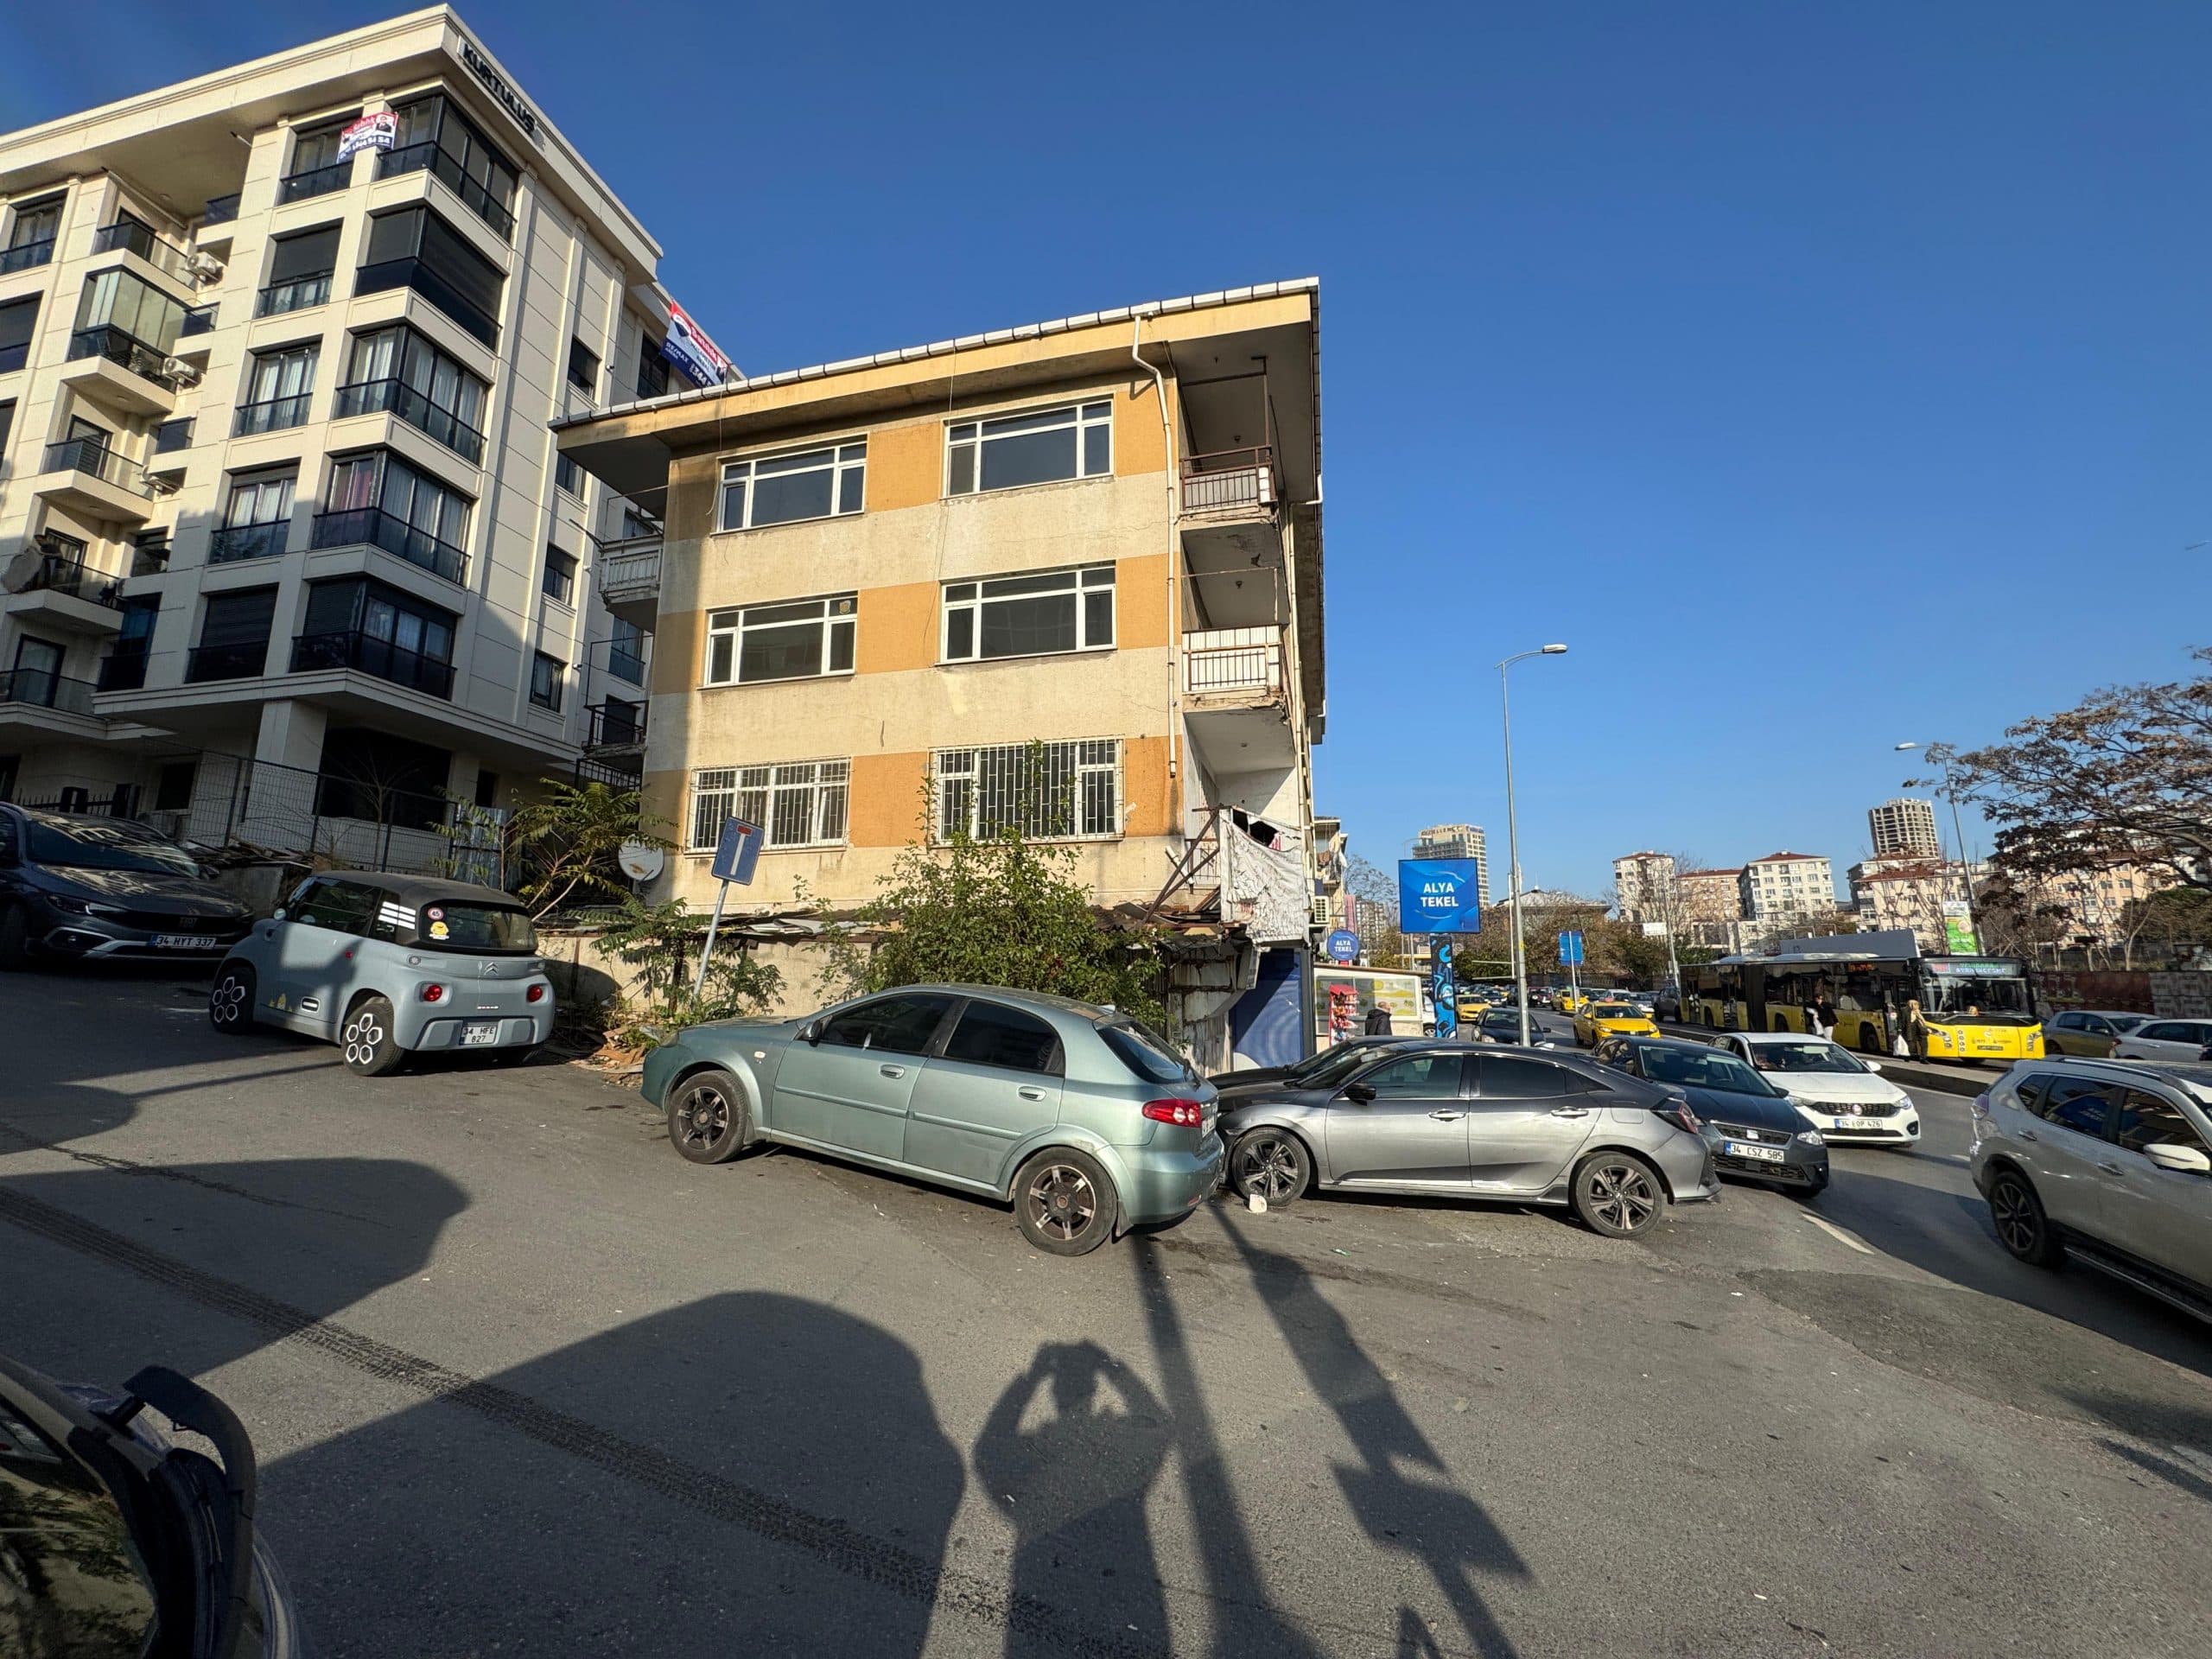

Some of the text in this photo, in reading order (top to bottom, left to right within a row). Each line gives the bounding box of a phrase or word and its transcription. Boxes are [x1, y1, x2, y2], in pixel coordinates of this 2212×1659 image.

[665, 342, 690, 363] RE/MAX
[1423, 882, 1454, 893] ALYA
[1420, 896, 1459, 907] TEKEL
[156, 937, 213, 947] 34 HYT 337
[1732, 1144, 1741, 1154] 34
[1747, 1147, 1763, 1158] CSZ
